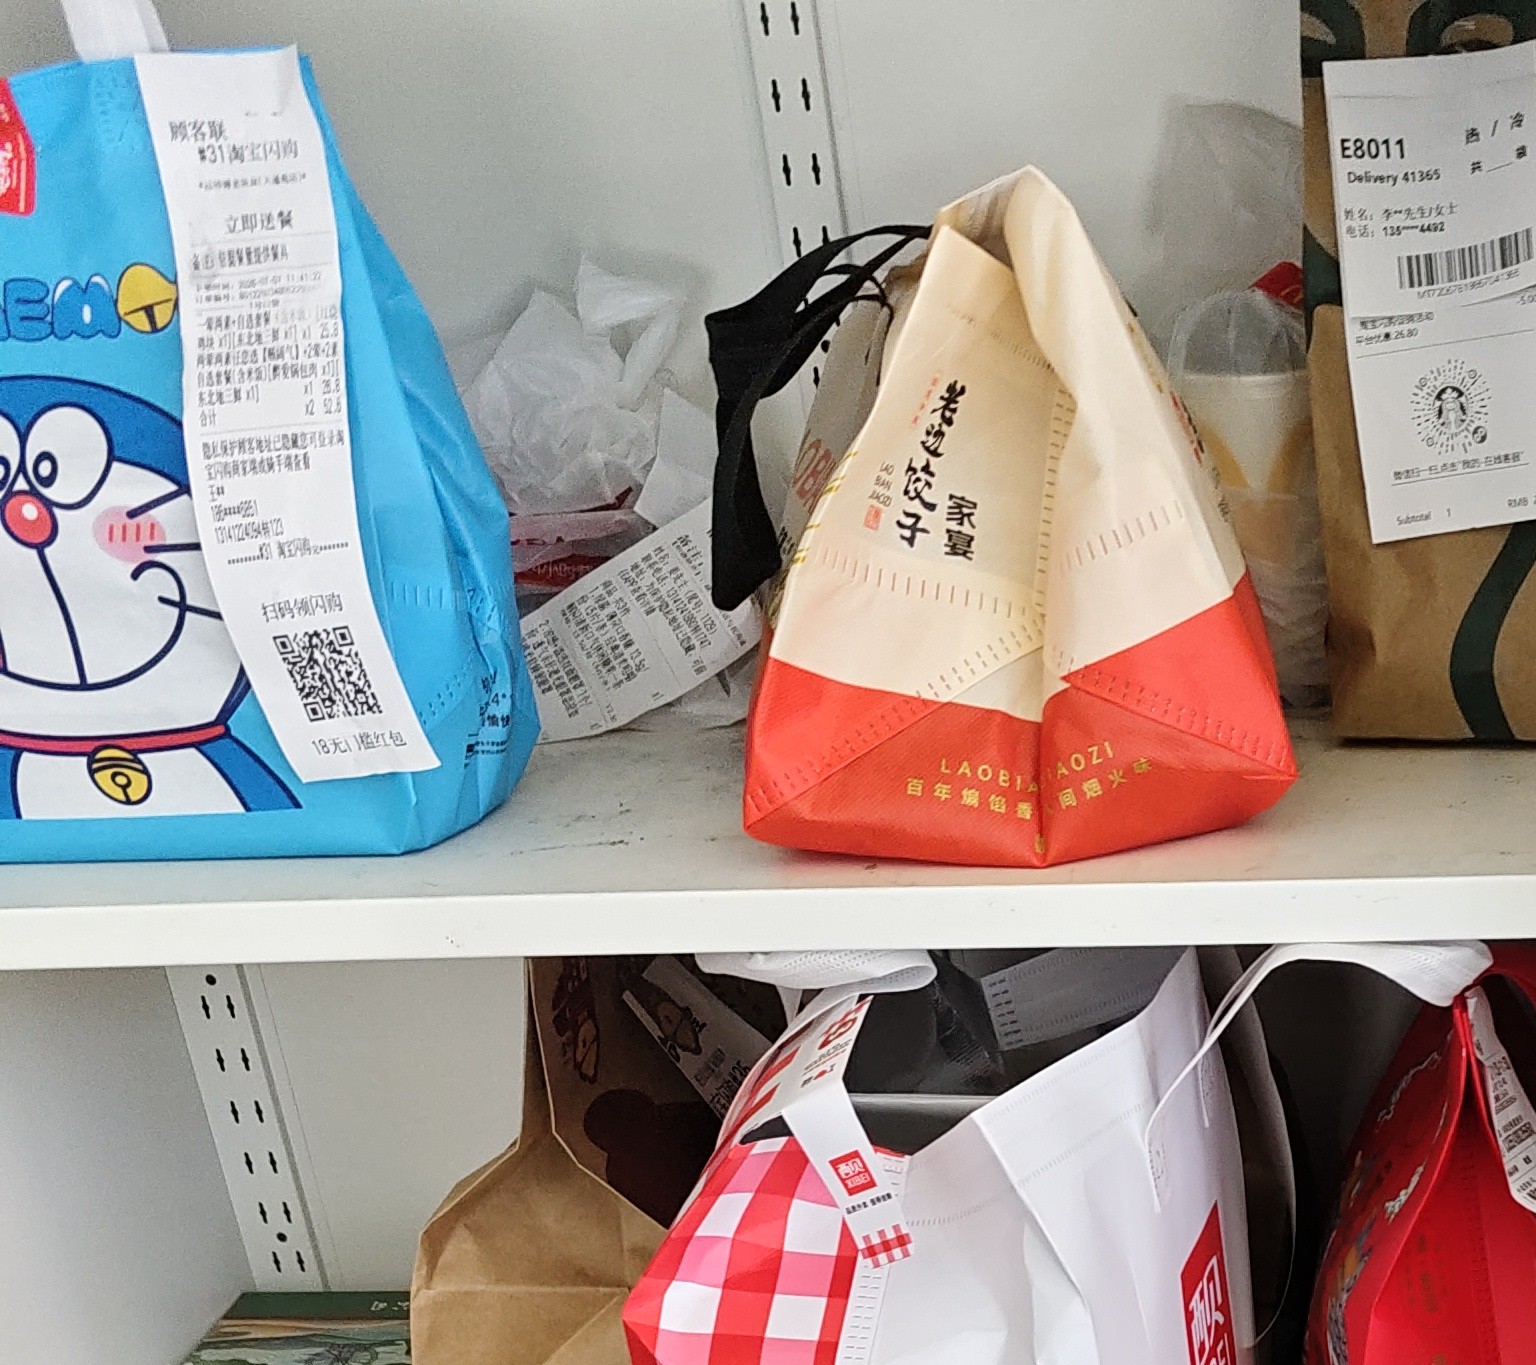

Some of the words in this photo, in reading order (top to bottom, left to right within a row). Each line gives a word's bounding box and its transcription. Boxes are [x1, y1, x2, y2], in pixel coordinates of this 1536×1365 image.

[1340, 138, 1405, 159] E8011
[1348, 171, 1398, 186] Delivery
[1401, 169, 1440, 184] 41365
[224, 210, 292, 234] 立即送餐
[896, 380, 967, 548] 老边饺子
[944, 494, 978, 561] 家宴
[261, 592, 343, 622] 扫码领闪购
